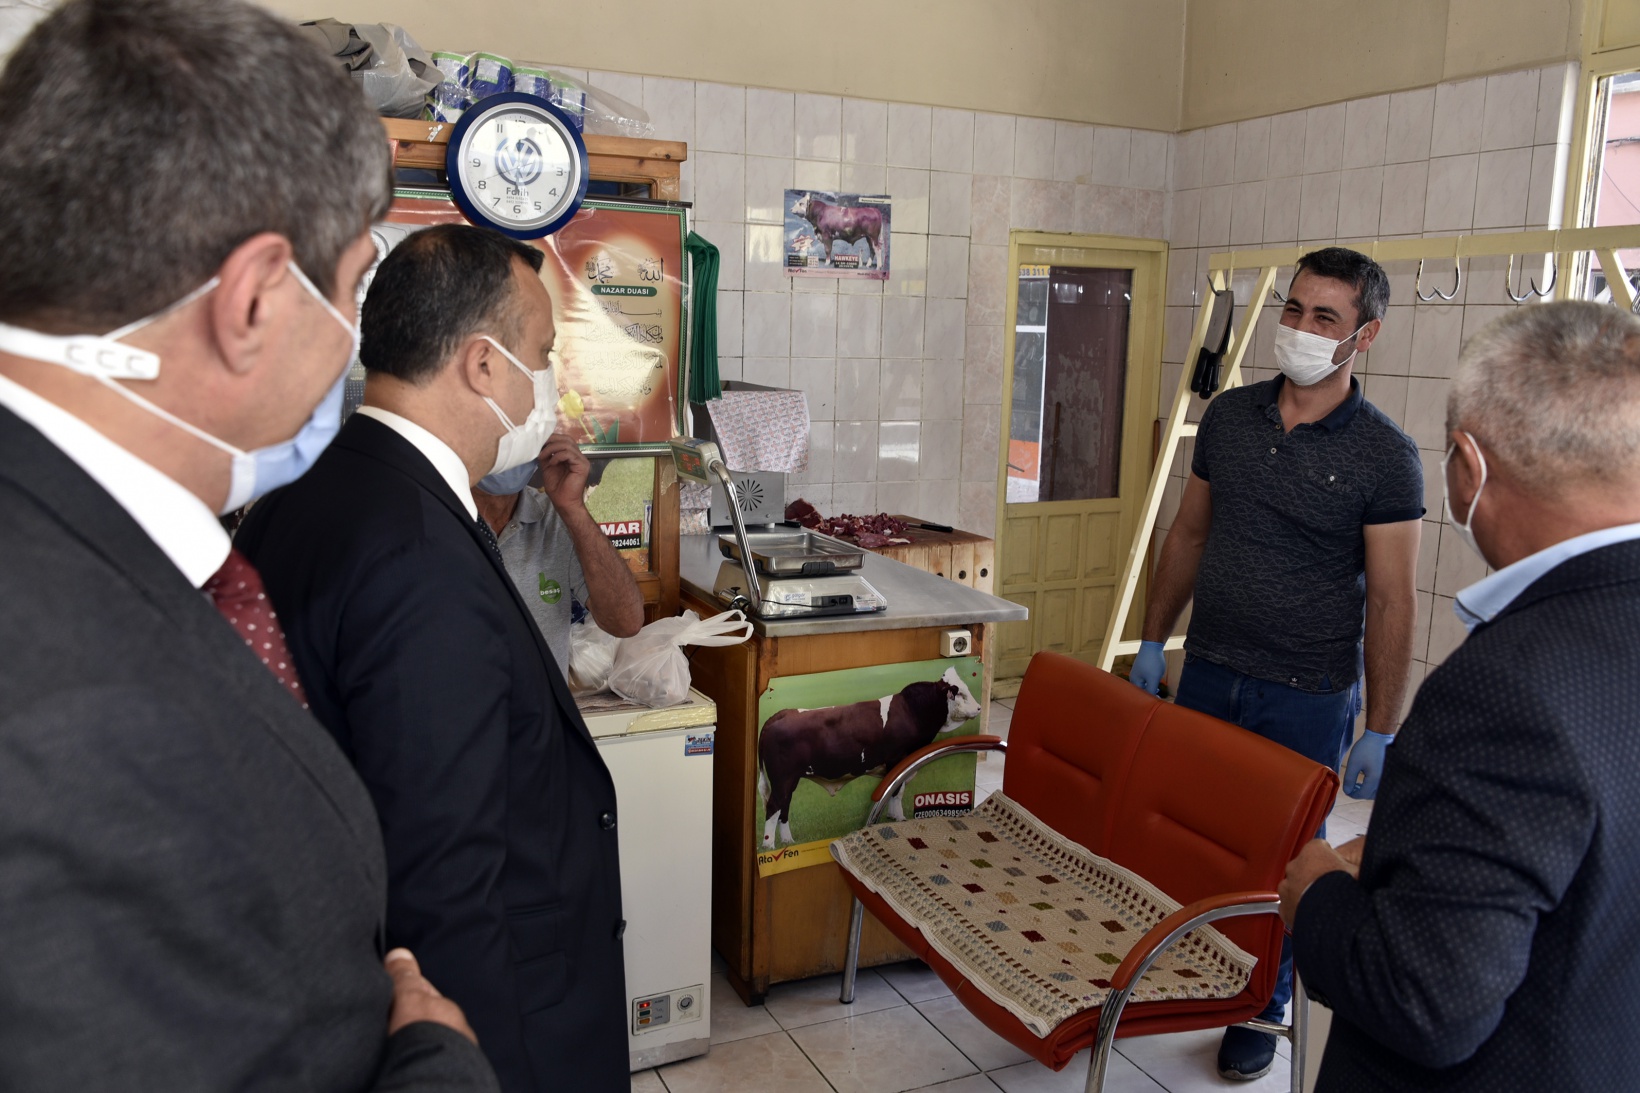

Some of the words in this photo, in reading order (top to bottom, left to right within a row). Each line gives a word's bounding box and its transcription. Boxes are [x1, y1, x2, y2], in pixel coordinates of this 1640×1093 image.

[472, 158, 482, 168] 9
[555, 167, 564, 177] 3
[477, 180, 487, 190] 8
[548, 187, 557, 197] 4
[492, 197, 501, 207] 7
[533, 201, 542, 211] 5
[512, 204, 522, 214] 6
[914, 792, 970, 807] ONASIS
[758, 854, 773, 865] Ata
[783, 849, 799, 859] Fen
